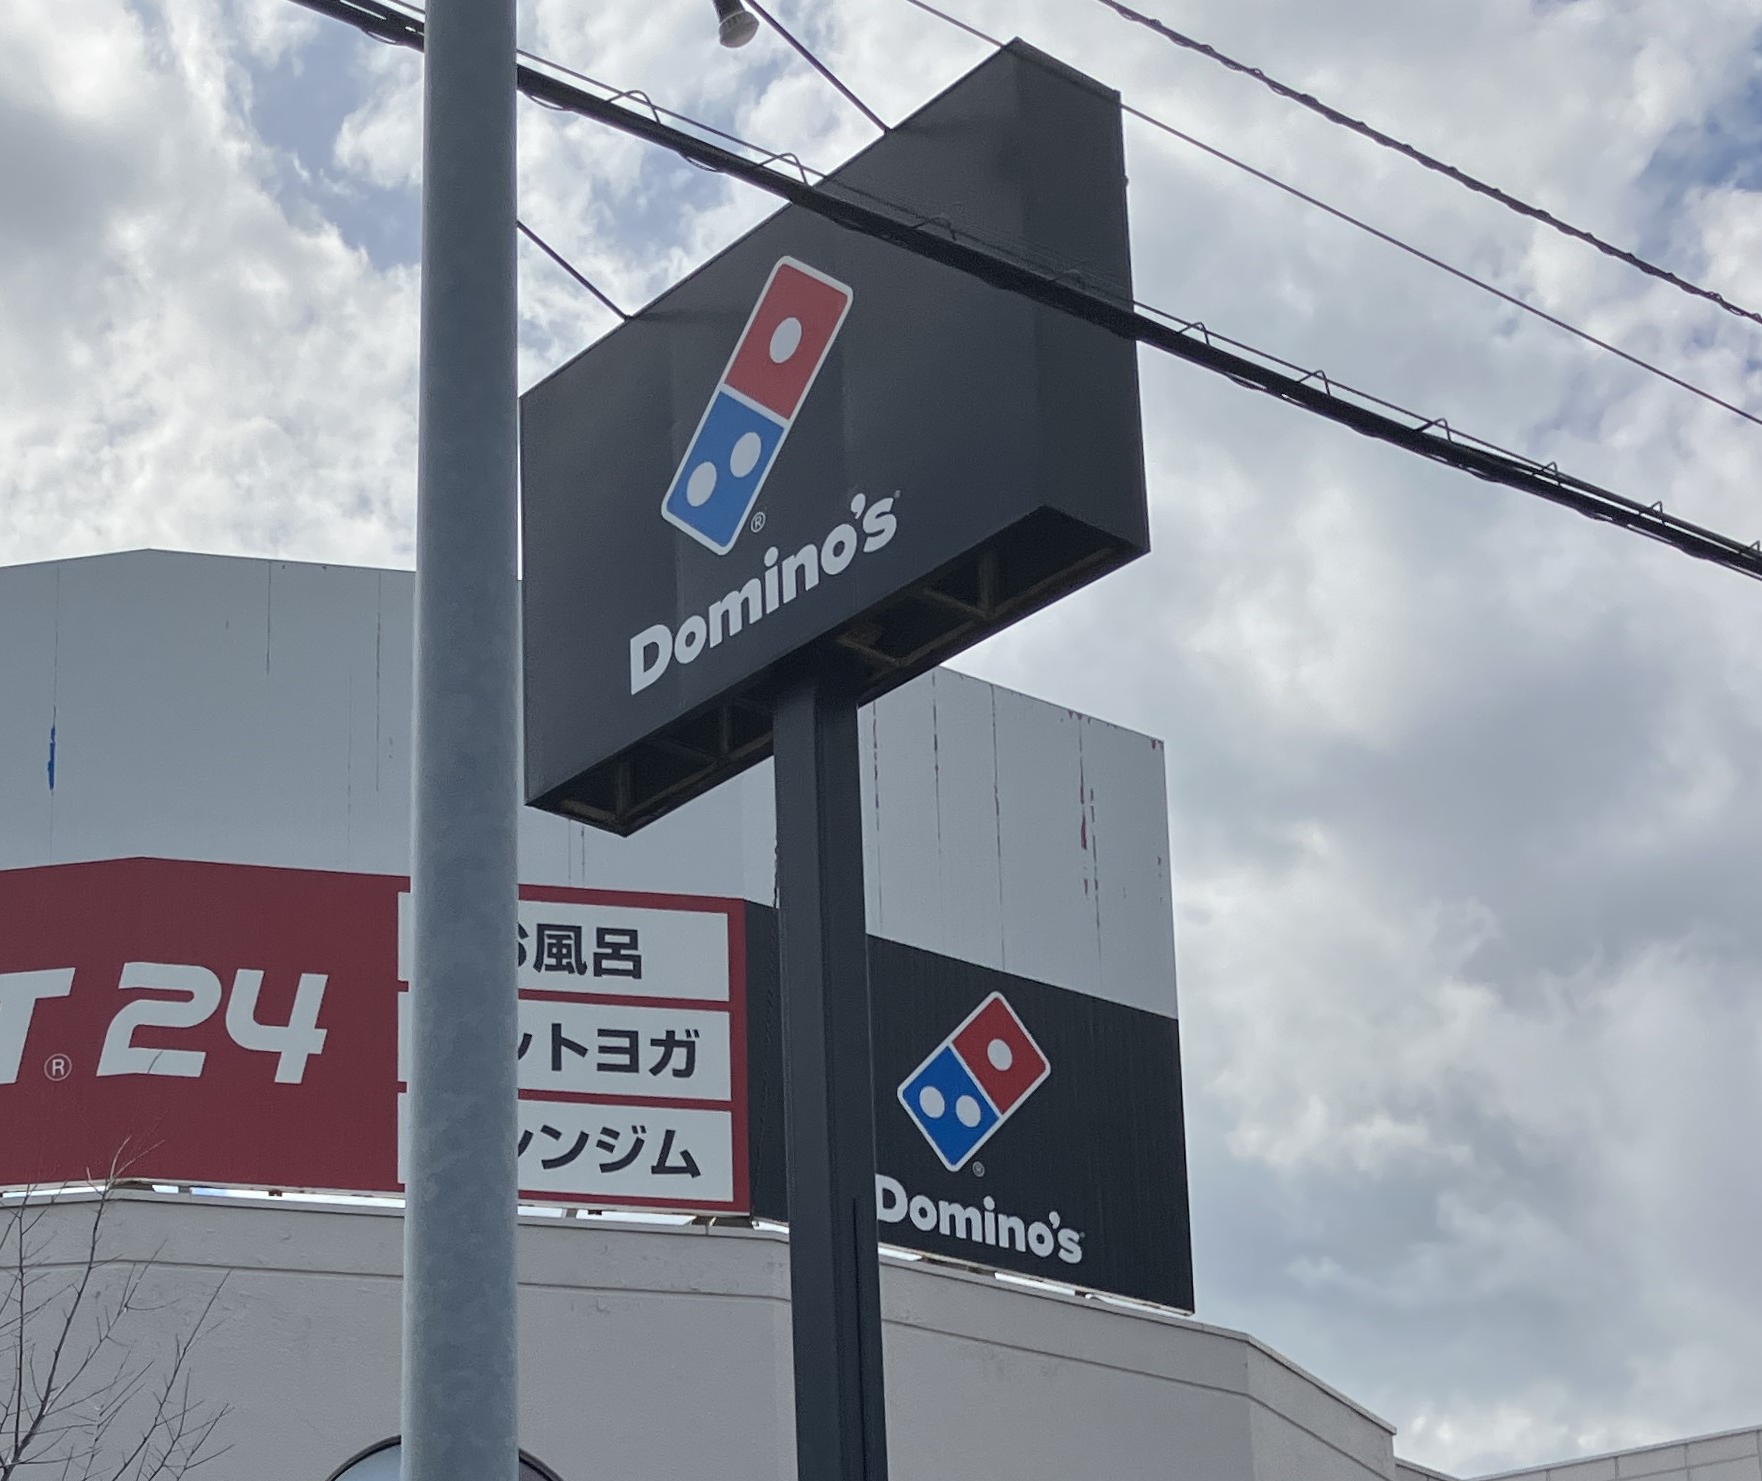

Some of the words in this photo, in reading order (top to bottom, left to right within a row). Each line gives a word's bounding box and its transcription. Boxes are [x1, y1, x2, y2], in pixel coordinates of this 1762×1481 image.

[630, 493, 897, 695] Domino's
[96, 961, 330, 1085] 24
[875, 1173, 1084, 1264] Domino's
